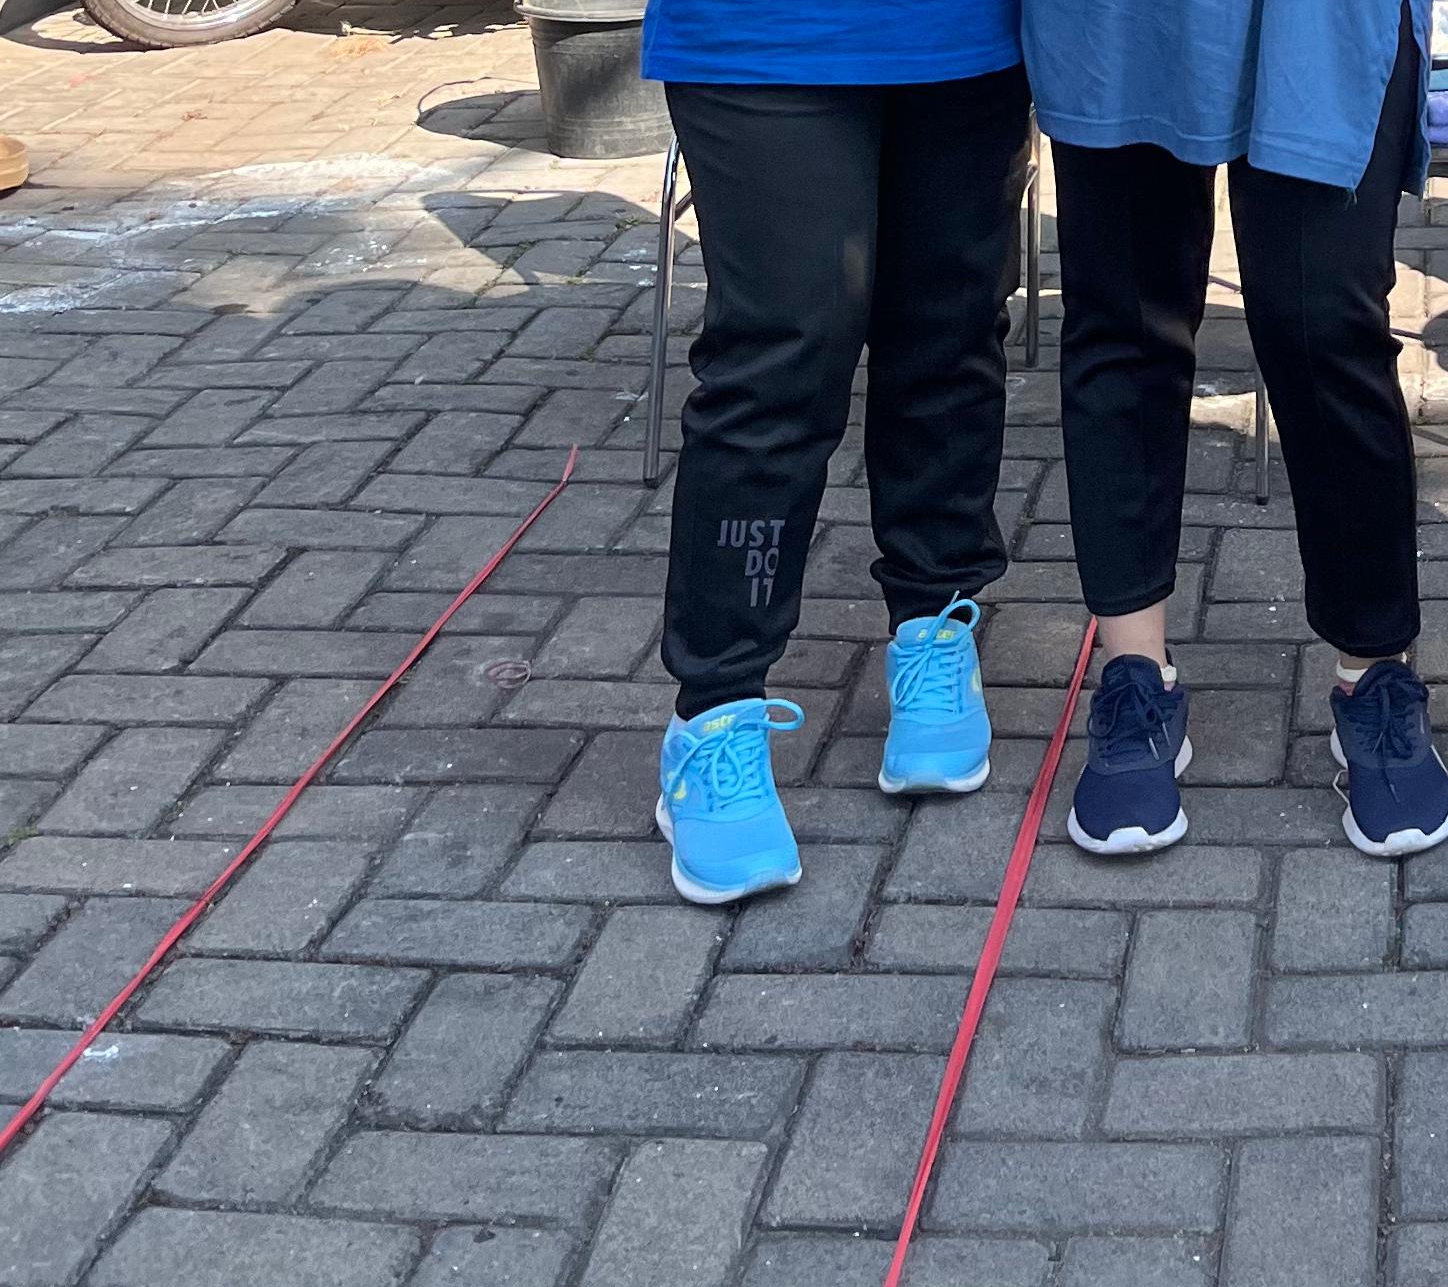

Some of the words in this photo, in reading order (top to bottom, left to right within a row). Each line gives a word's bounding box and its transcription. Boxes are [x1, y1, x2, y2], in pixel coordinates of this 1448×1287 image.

[717, 519, 786, 548] JUST
[744, 548, 780, 577] DO
[750, 577, 775, 608] IT
